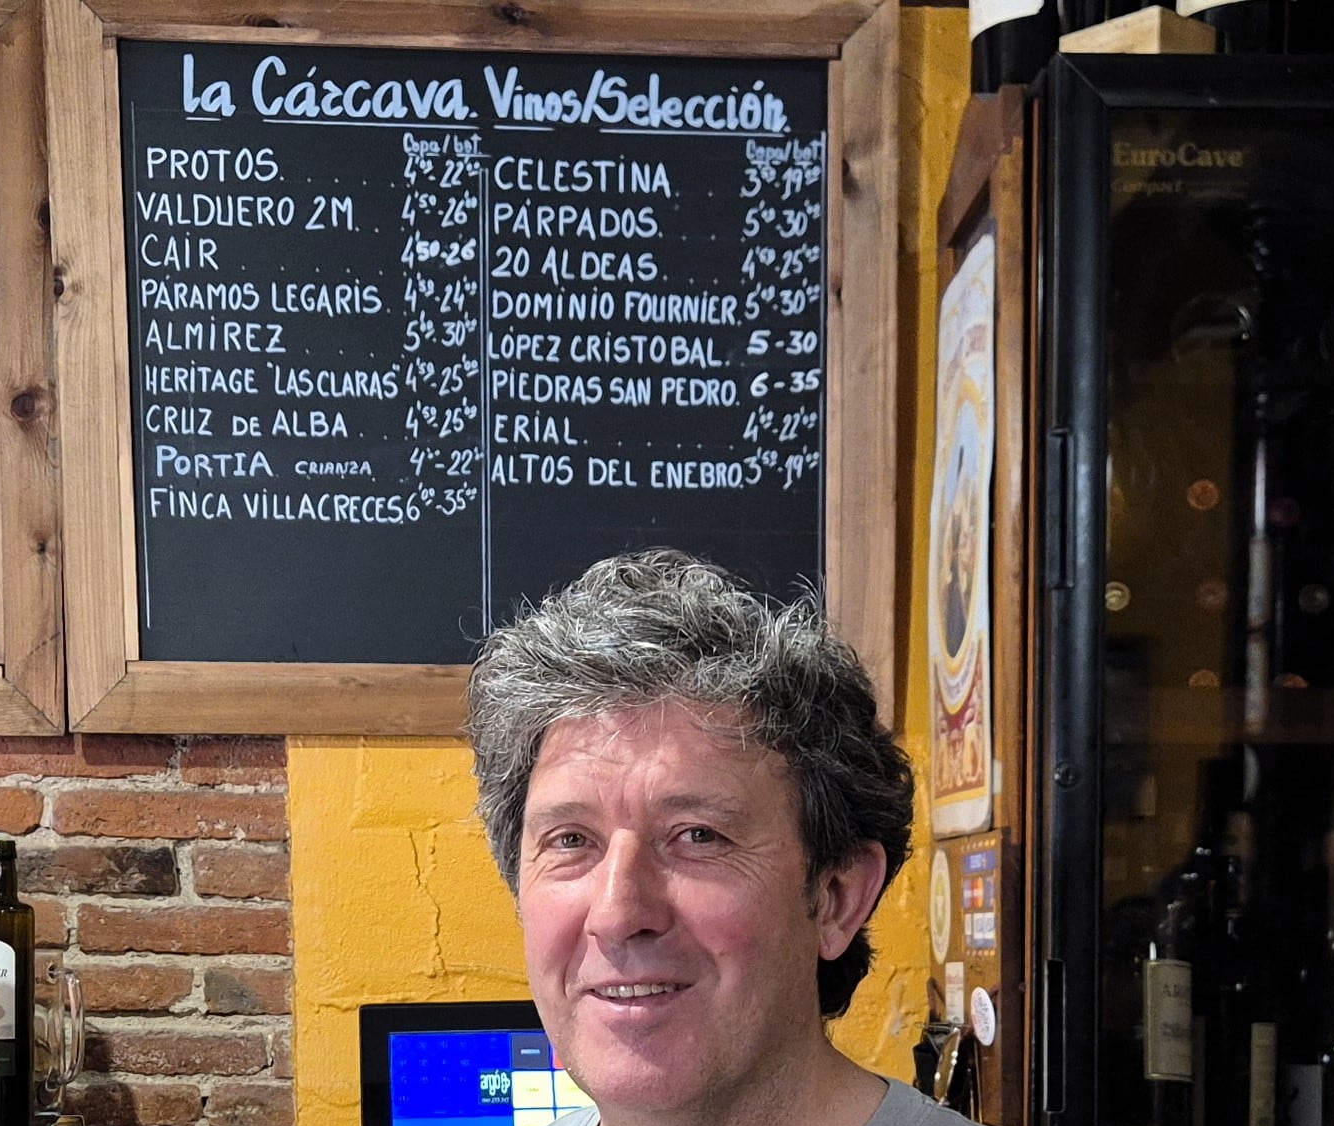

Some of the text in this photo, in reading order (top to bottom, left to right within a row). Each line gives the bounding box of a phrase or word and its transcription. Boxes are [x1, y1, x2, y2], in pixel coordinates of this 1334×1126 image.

[147, 147, 279, 182] PROTOS
[494, 155, 671, 199] CELESTINA
[137, 191, 356, 231] VALDUERO 2M
[141, 231, 219, 271] CAIR
[492, 247, 658, 286] 20 ALDEAS
[272, 278, 382, 316] LEGARIS
[492, 287, 737, 324] DOMINIO FOURNIER
[145, 361, 259, 395] HERITAGE
[492, 368, 735, 406] PIEDRAS SAN PEDRO
[145, 405, 348, 438] CRUZ DE ALBA
[494, 410, 578, 445] ERIAL
[156, 445, 372, 478] PORTIA CRIANZA
[491, 454, 742, 488] ALTOS DEL ENEBRO
[150, 485, 403, 523] FINCA VILLACRECES
